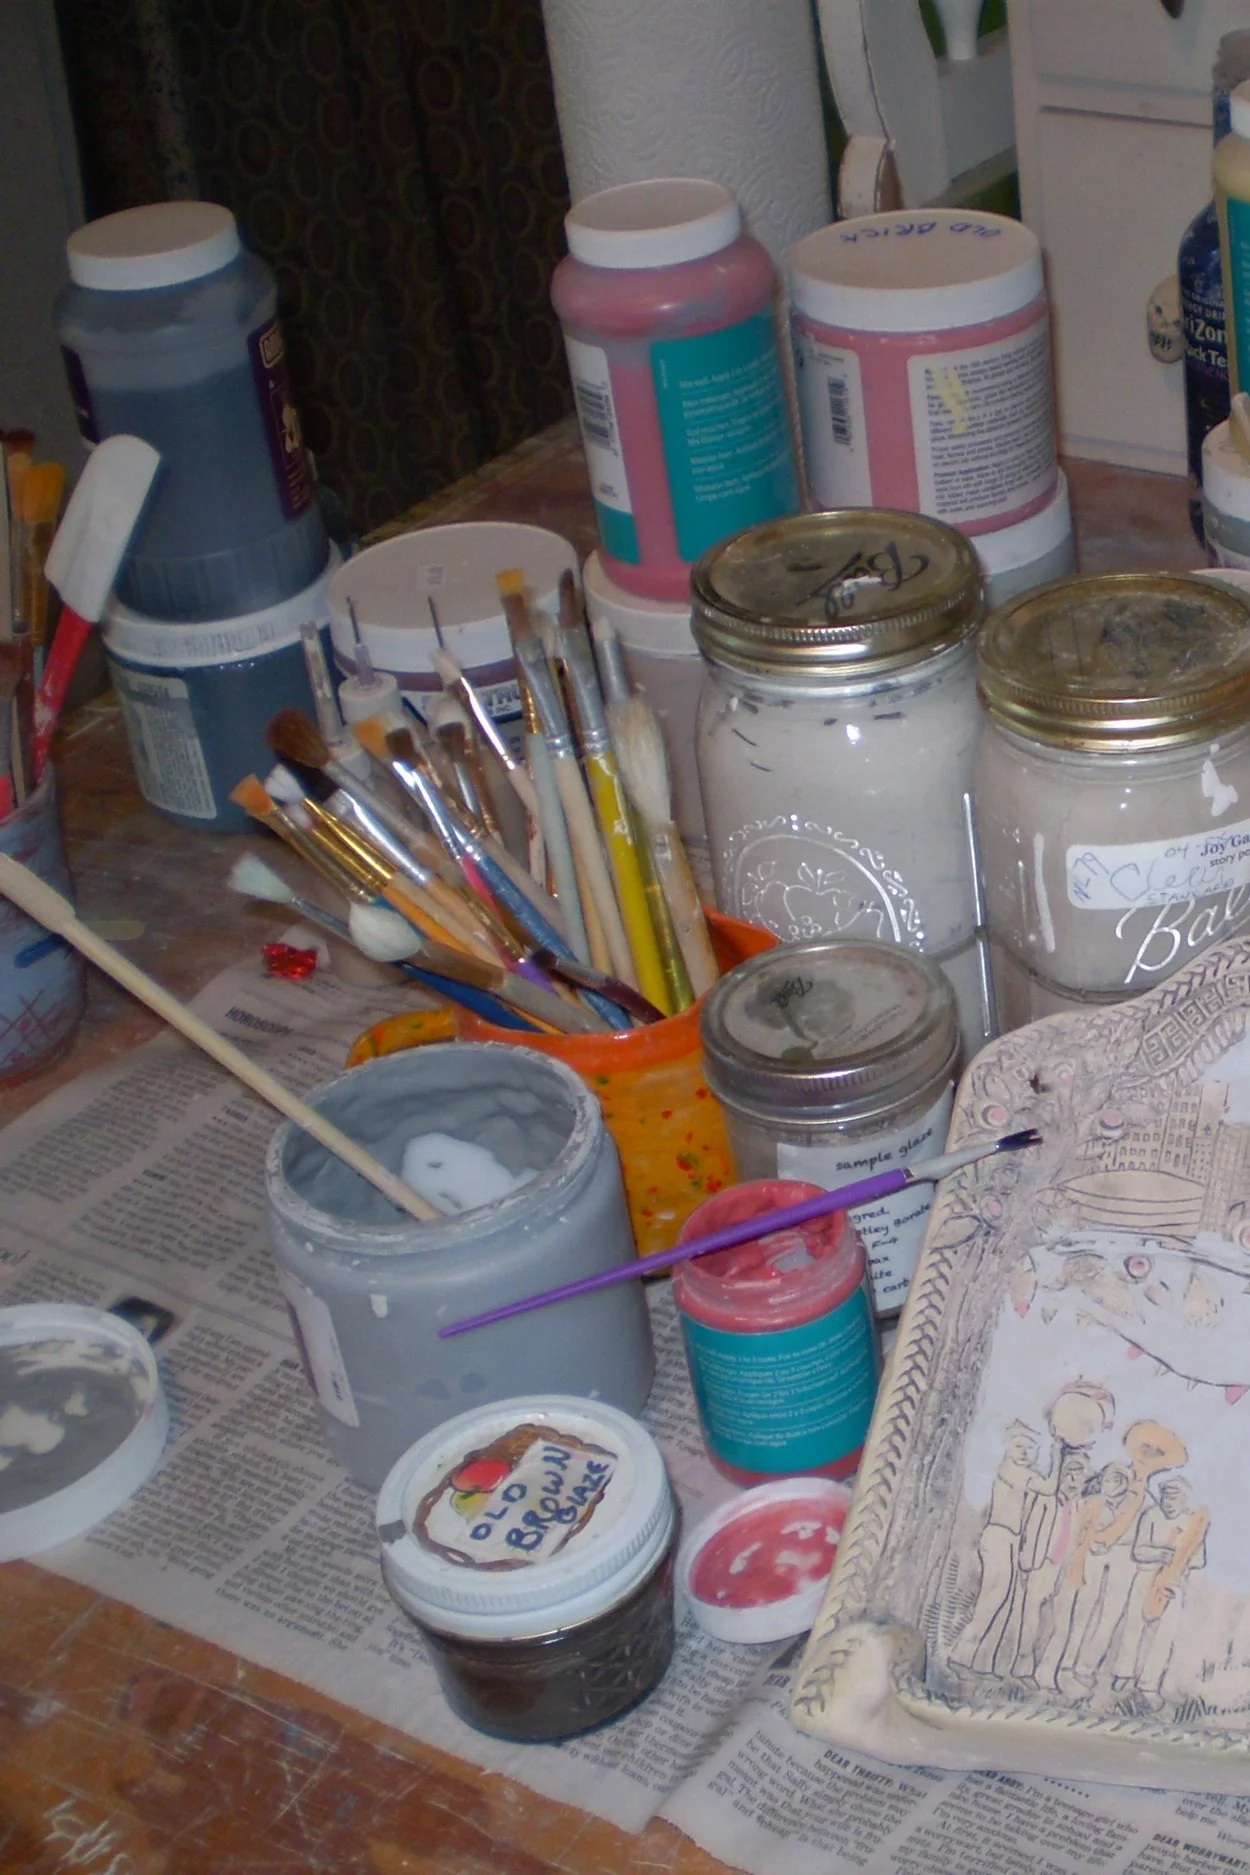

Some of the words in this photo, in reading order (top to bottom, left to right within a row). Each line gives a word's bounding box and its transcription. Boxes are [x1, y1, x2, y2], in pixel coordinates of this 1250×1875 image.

[1200, 838, 1228, 858] Joy
[1209, 851, 1236, 868] story
[836, 1150, 894, 1172] sample
[898, 1127, 934, 1158] glaze
[469, 1482, 528, 1541] OLD
[505, 1445, 572, 1551] BROWN
[554, 1459, 611, 1525] GLAZE
[822, 1748, 851, 1770] DEAR
